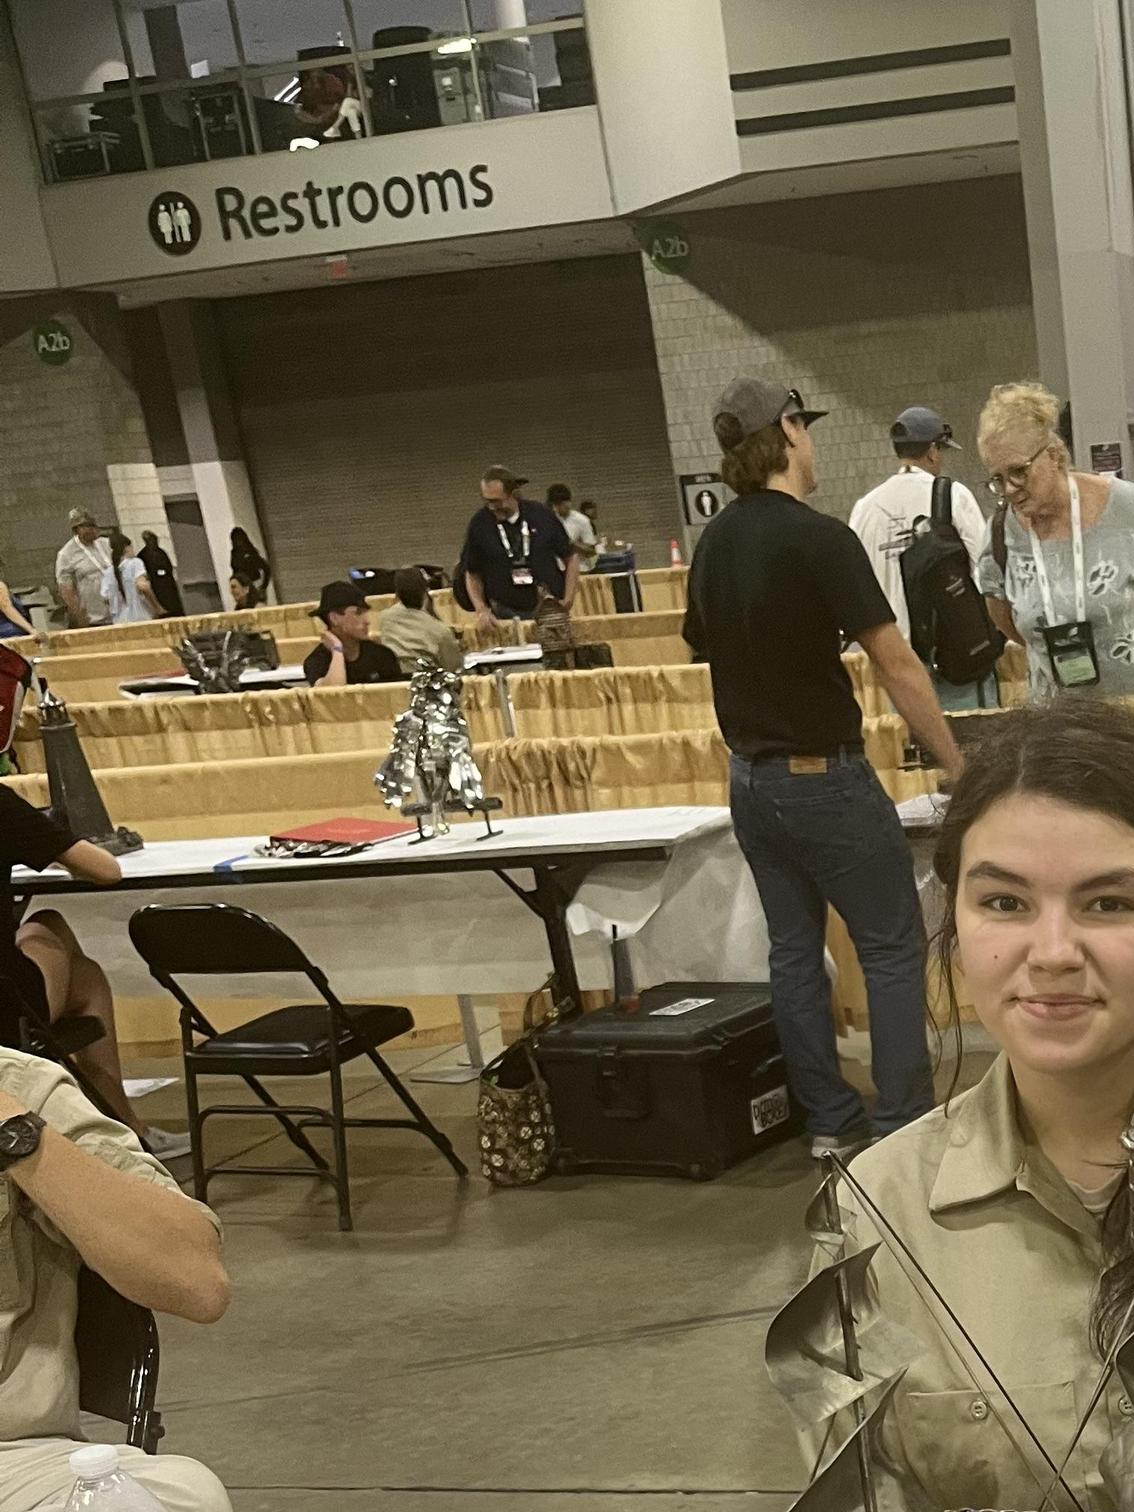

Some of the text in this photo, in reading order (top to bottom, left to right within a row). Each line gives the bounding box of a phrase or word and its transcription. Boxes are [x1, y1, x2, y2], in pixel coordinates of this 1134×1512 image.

[215, 164, 494, 242] Restrooms
[651, 235, 689, 260] A2b
[38, 331, 71, 353] A2b
